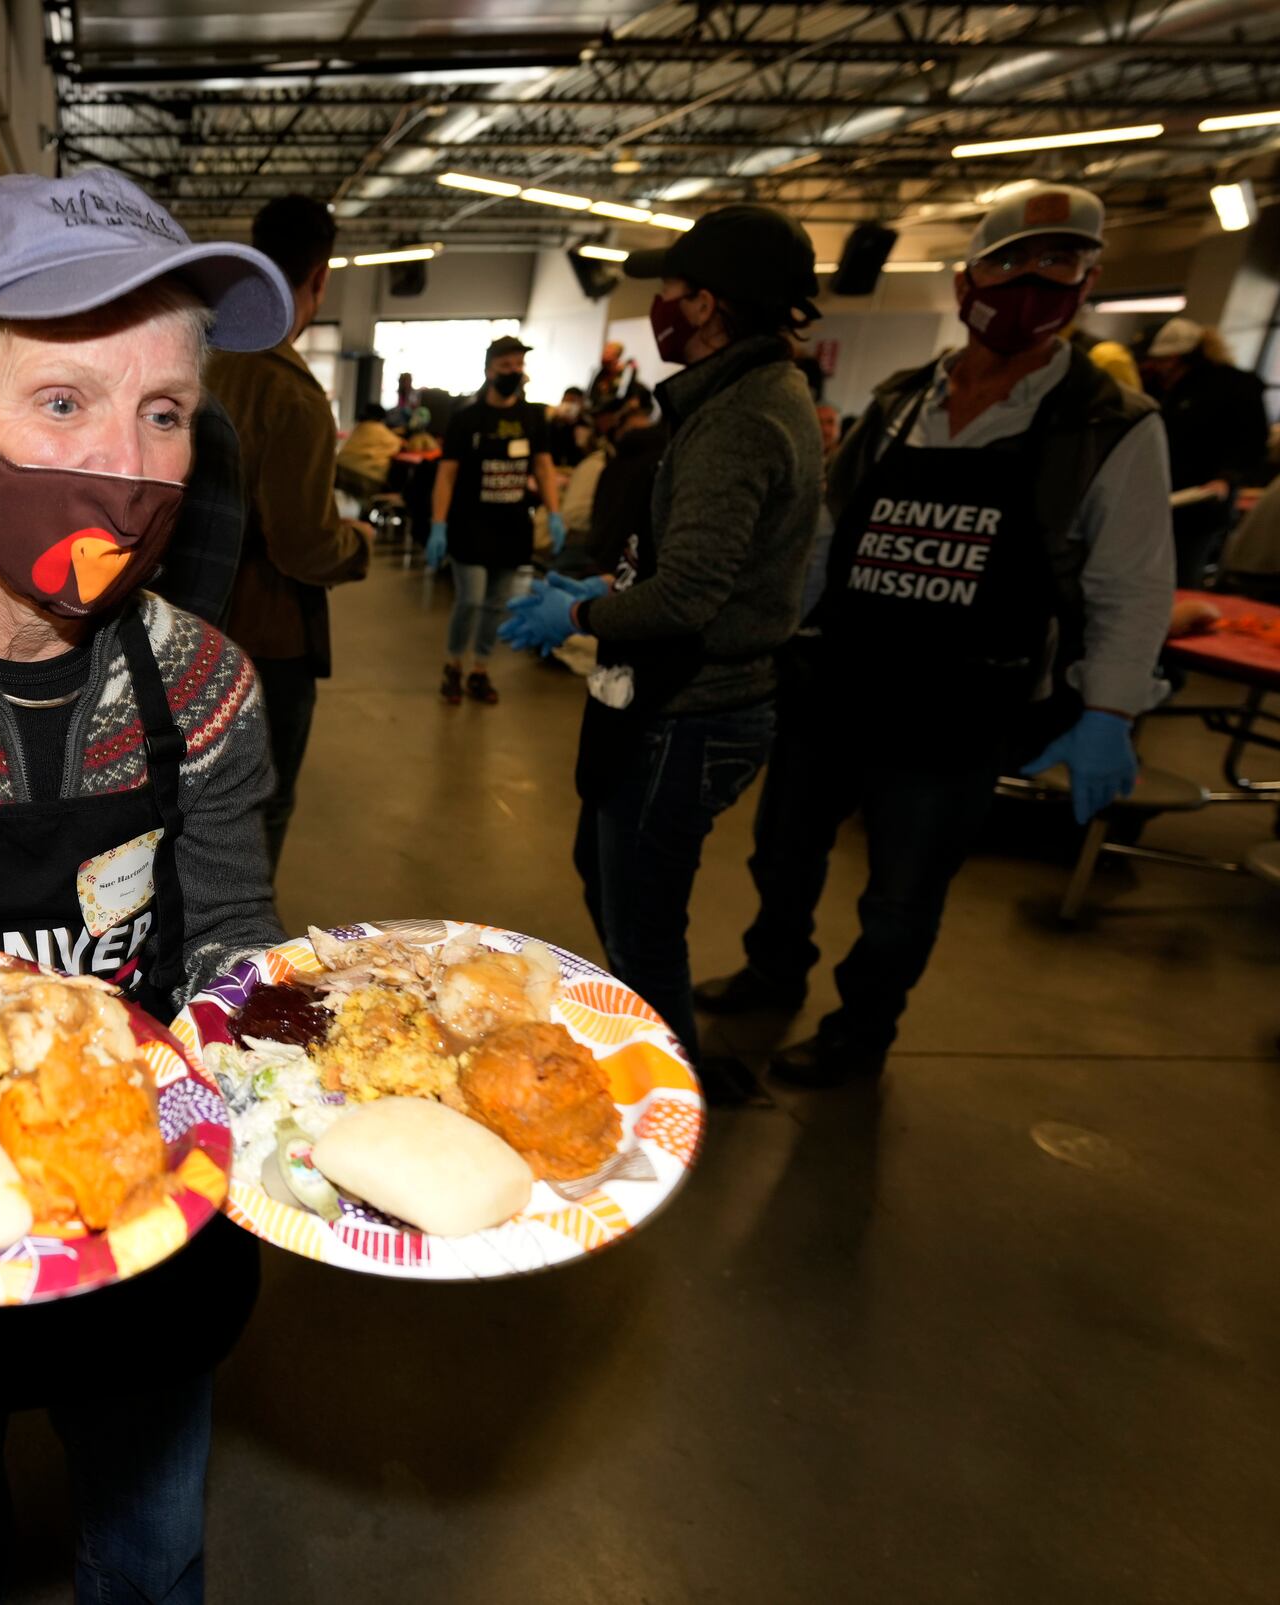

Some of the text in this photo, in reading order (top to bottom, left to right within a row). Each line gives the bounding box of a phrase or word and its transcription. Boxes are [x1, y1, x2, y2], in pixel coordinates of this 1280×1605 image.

[871, 498, 1002, 535] DENVER
[857, 532, 991, 571] RESCUE
[848, 565, 978, 606] MISSION
